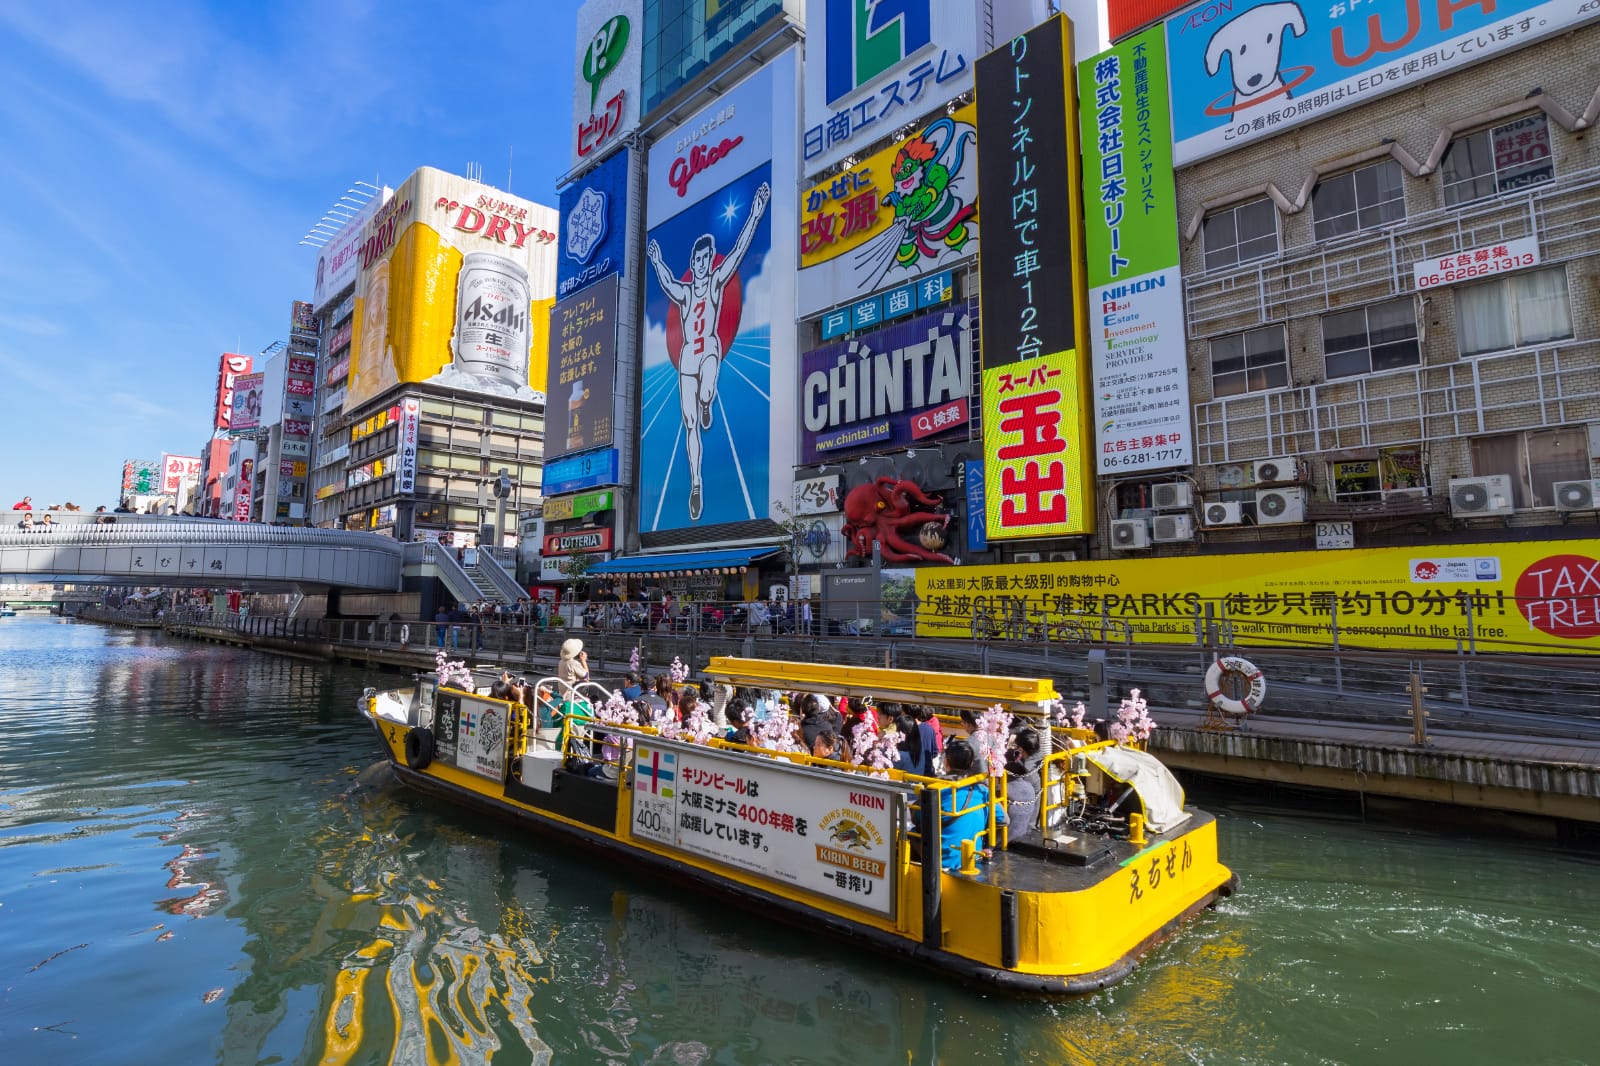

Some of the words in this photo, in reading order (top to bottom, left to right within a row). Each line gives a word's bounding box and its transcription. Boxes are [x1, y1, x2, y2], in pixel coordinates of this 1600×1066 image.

[1224, 15, 1548, 141] この看板の照明はLEDを使用しています。
[804, 50, 967, 161] 日商エステム
[577, 89, 625, 157] ピップ
[676, 104, 737, 153] おいしさと健康
[1133, 42, 1156, 217] 不動産再生のスペシャリスト
[669, 135, 744, 198] Glico
[1095, 55, 1130, 277] 株式会社日本リート
[807, 168, 873, 213] かぜに
[479, 194, 528, 220] SUPER
[800, 186, 881, 255] 改源
[1418, 253, 1535, 288] 06-6262-1313
[1439, 245, 1509, 271] 広告募集
[560, 257, 611, 295] 雪印メグミルク
[1103, 275, 1166, 301] NIHON
[464, 295, 525, 334] Asahi
[827, 276, 945, 335] 戸堂歯科
[1103, 301, 1131, 315] Real
[693, 297, 707, 355] グリコ
[1103, 312, 1140, 327] Estate
[1104, 321, 1156, 339] Investment
[484, 332, 503, 347] 生
[561, 336, 583, 355] 大阪の
[1104, 333, 1159, 350] Technology
[561, 342, 602, 369] がんばる人を
[1105, 346, 1145, 361] SERVICE
[1106, 353, 1154, 369] PROVIDER
[560, 360, 598, 385] 応援します。
[998, 364, 1061, 393] スーパー
[933, 405, 961, 427] 検索
[1103, 431, 1181, 454] 広告主募集中
[402, 446, 416, 490] かに道楽
[997, 389, 1067, 528] 玉出
[1103, 448, 1183, 468] 06-6281-1717
[957, 462, 966, 487] 2F
[560, 535, 598, 548] LOTTERIA
[1317, 523, 1353, 537] BAR
[134, 556, 223, 571] えびす橋
[926, 572, 1120, 592] 从这里到大阪最大级别的购物中心
[1528, 560, 1600, 600] TAX
[1242, 624, 1265, 634] walk
[1414, 625, 1427, 636] to
[1429, 625, 1450, 637] the
[1477, 625, 1508, 638] free.
[682, 766, 759, 798] キリンビールは
[681, 789, 808, 836] 大阪ミナミ400年祭を
[849, 791, 885, 811] KIRIN
[680, 812, 769, 852] 応援しています。
[841, 808, 866, 821] PRIME
[865, 820, 884, 846] BREW
[820, 848, 850, 867] KIRIN
[852, 857, 881, 875] BEER
[1129, 839, 1193, 904] えちぜん
[823, 870, 873, 895] 一番搾り
